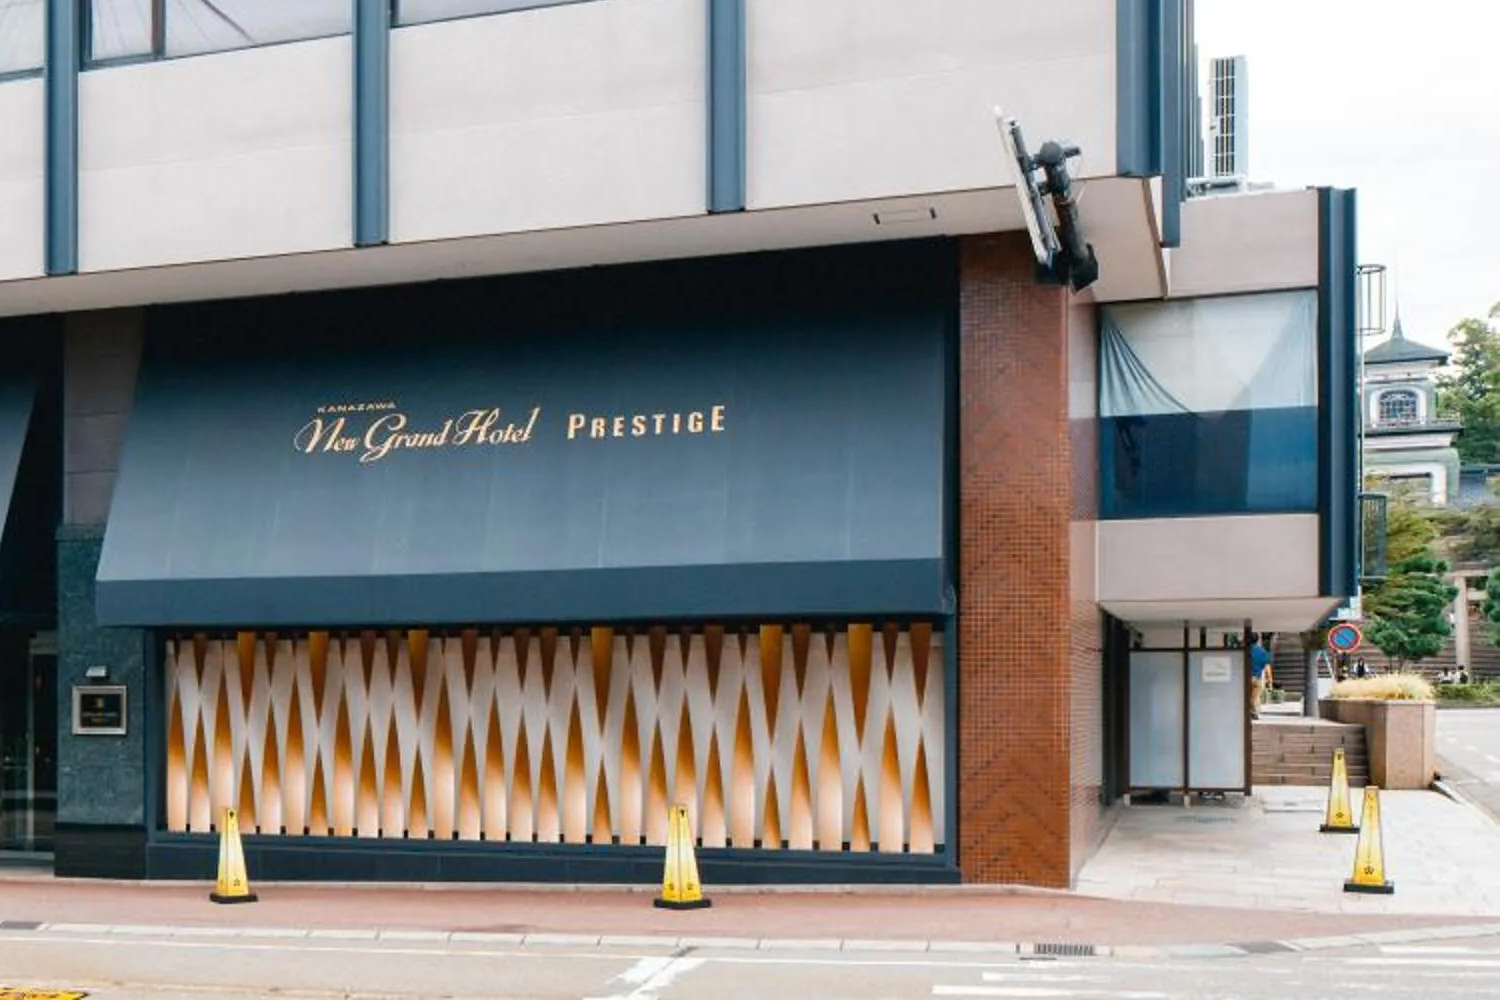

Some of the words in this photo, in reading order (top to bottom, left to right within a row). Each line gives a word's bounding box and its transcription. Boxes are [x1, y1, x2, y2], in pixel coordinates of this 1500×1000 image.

[317, 400, 397, 413] KANAZAWA
[293, 416, 359, 454] New
[359, 412, 453, 464] Grand
[452, 405, 542, 447] Hotel
[566, 405, 726, 440] PRESTIGE
